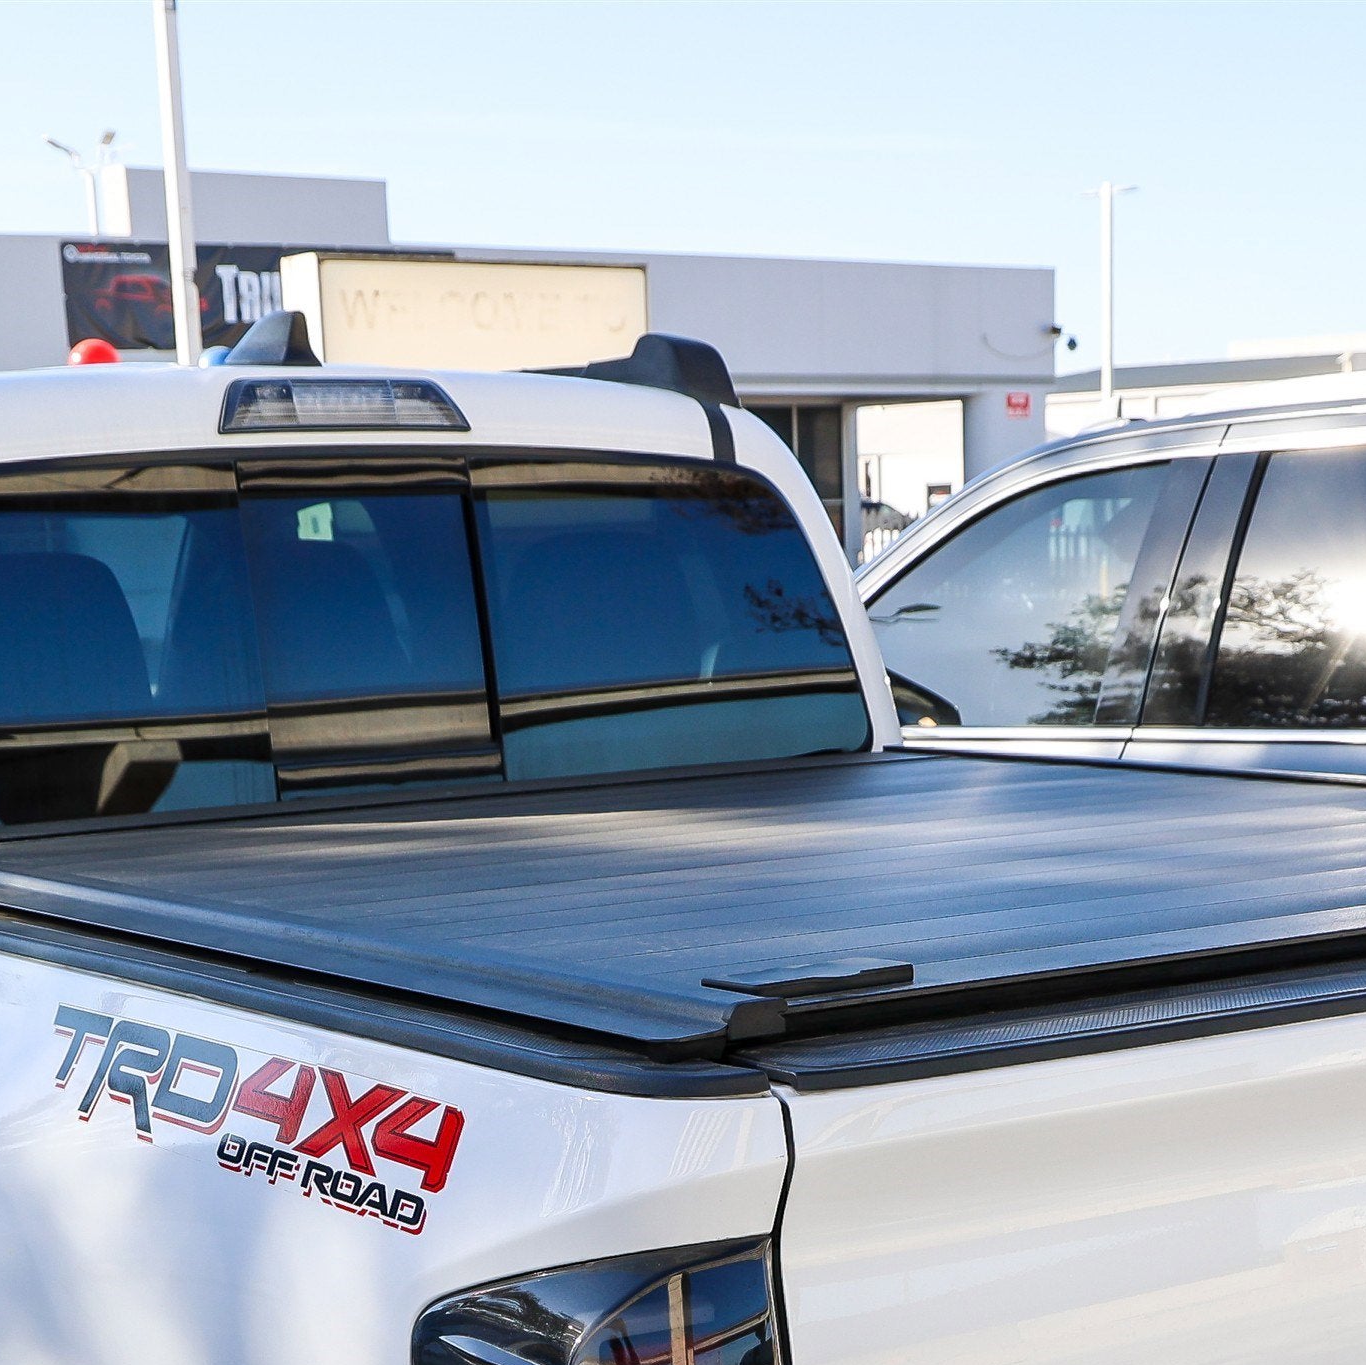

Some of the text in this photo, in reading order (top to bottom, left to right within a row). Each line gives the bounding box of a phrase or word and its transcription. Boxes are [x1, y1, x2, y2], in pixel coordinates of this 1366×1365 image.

[54, 1003, 241, 1143] TRD
[216, 1133, 428, 1236] OFF ROAD
